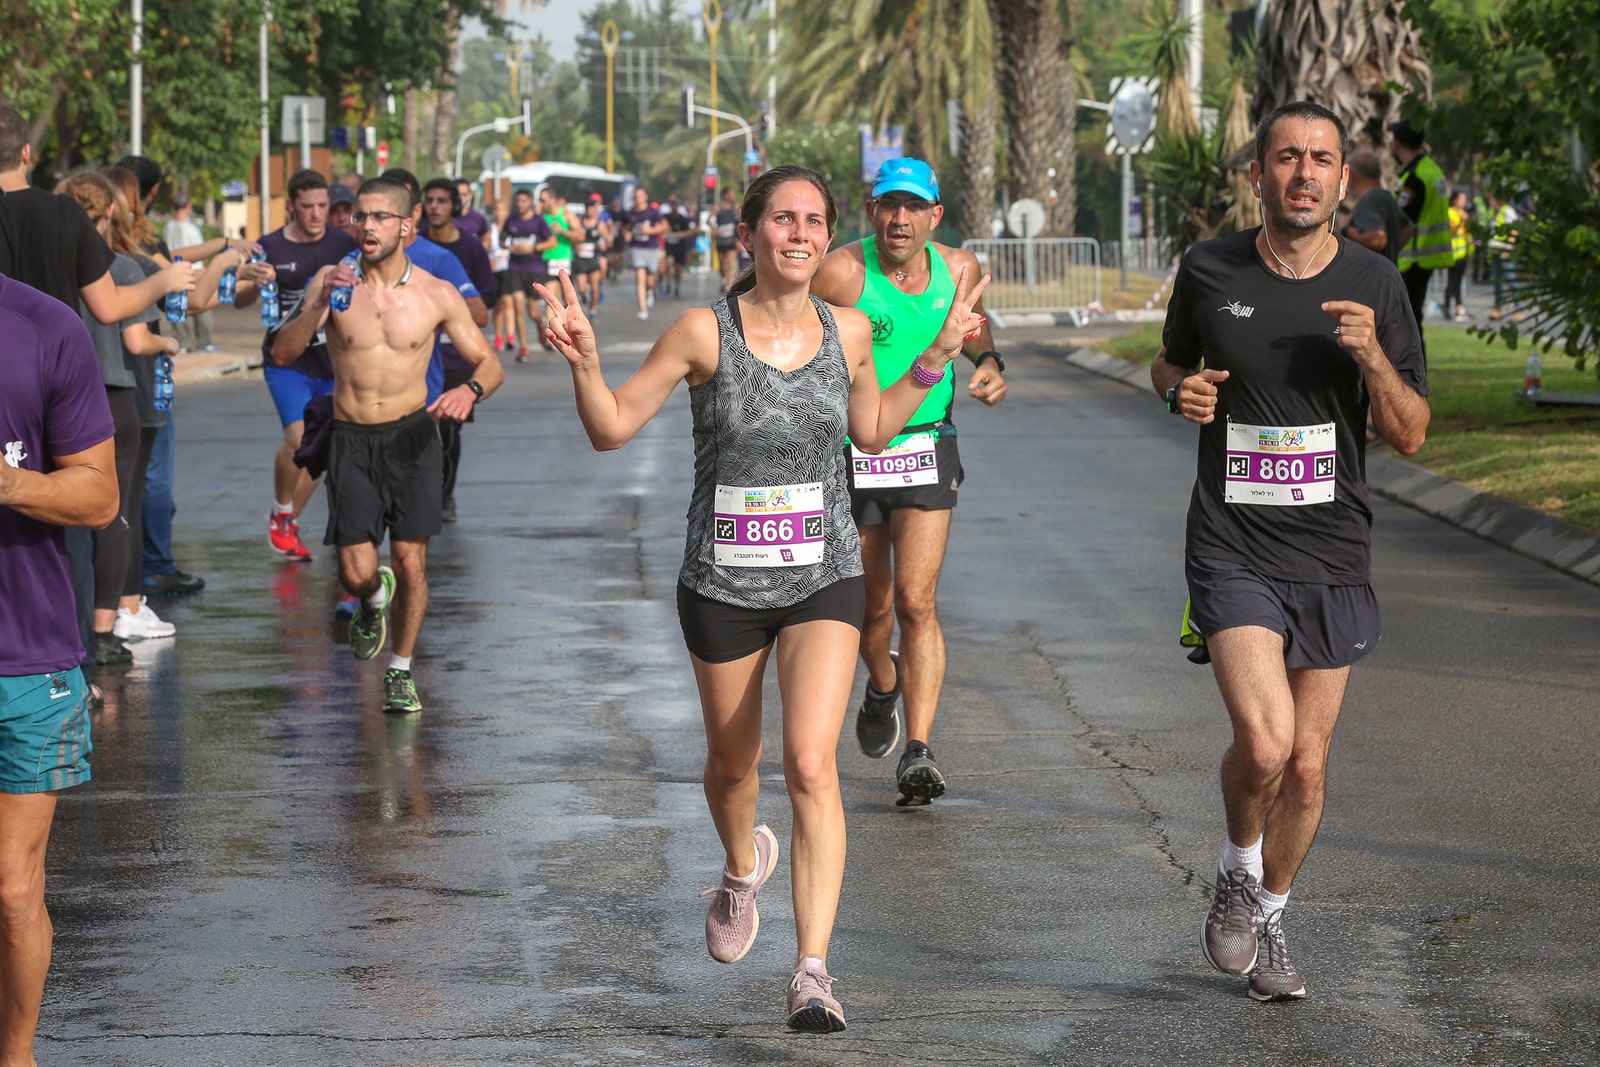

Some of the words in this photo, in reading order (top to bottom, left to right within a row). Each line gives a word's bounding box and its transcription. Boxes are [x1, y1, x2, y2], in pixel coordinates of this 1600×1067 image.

[872, 456, 917, 473] 1099
[1259, 458, 1305, 481] 860
[746, 518, 794, 542] 866
